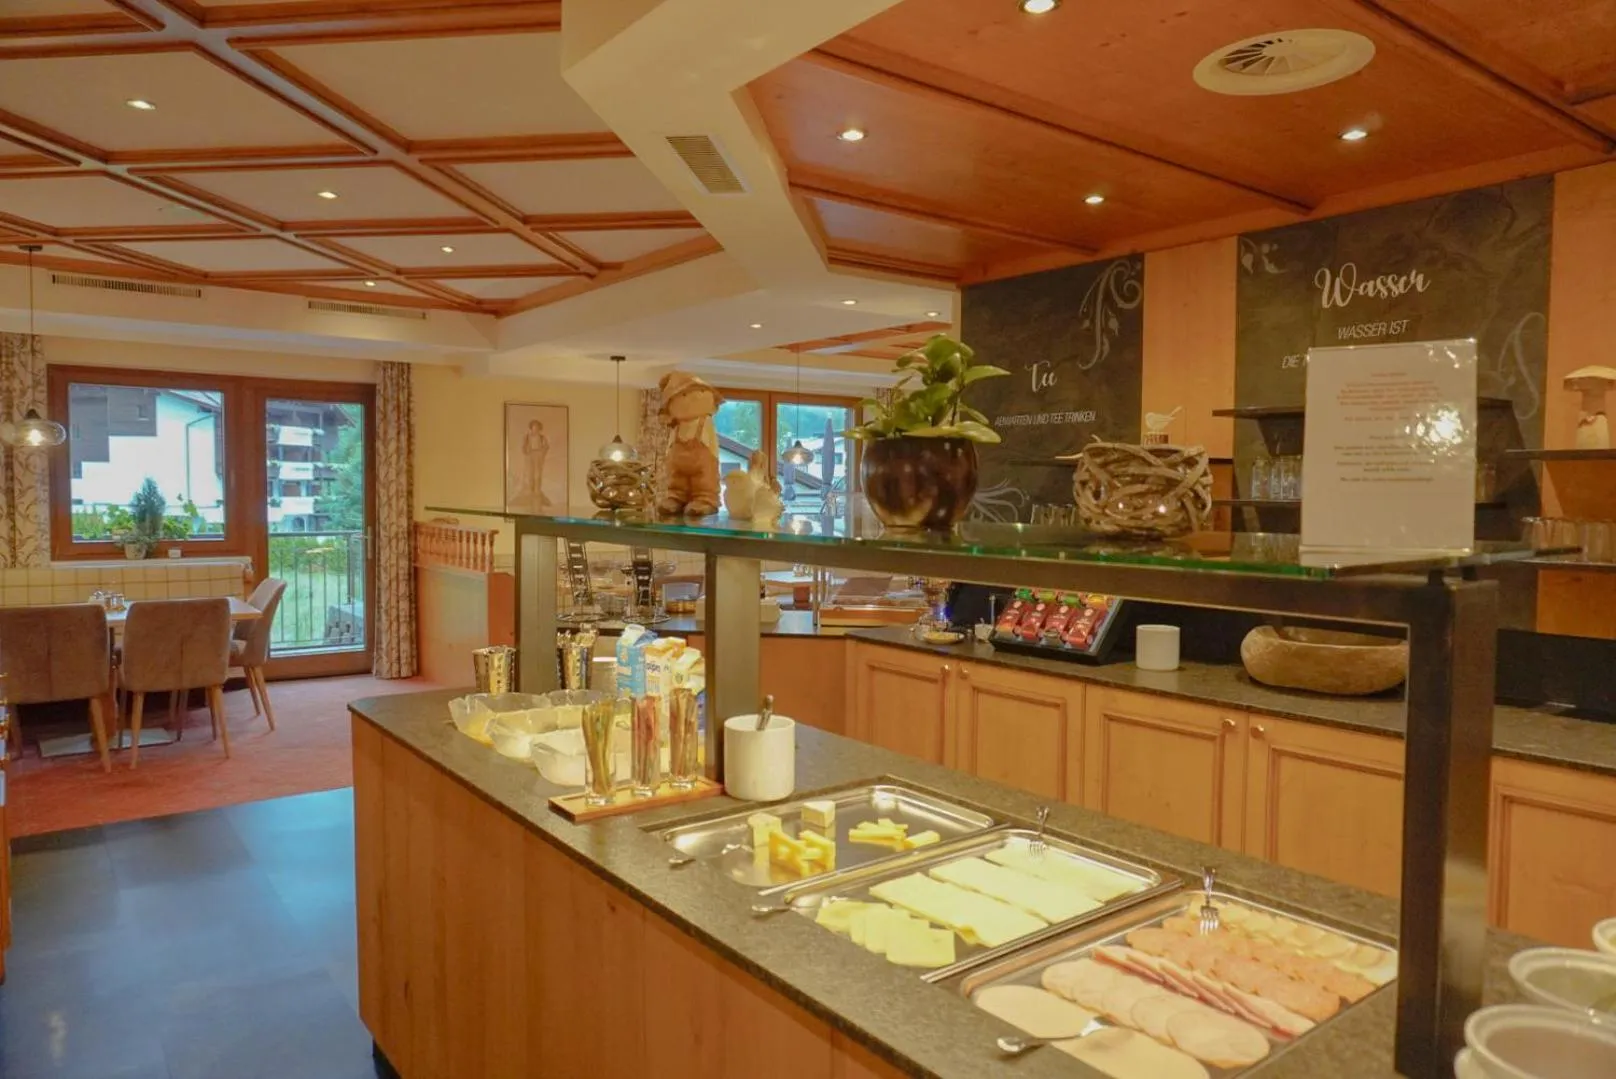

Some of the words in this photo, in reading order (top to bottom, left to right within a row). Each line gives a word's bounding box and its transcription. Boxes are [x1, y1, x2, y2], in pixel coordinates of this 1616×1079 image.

[1314, 262, 1431, 308] Wasser
[1337, 321, 1387, 340] WASSER
[1388, 319, 1410, 334] IST
[1024, 360, 1058, 393] Tee
